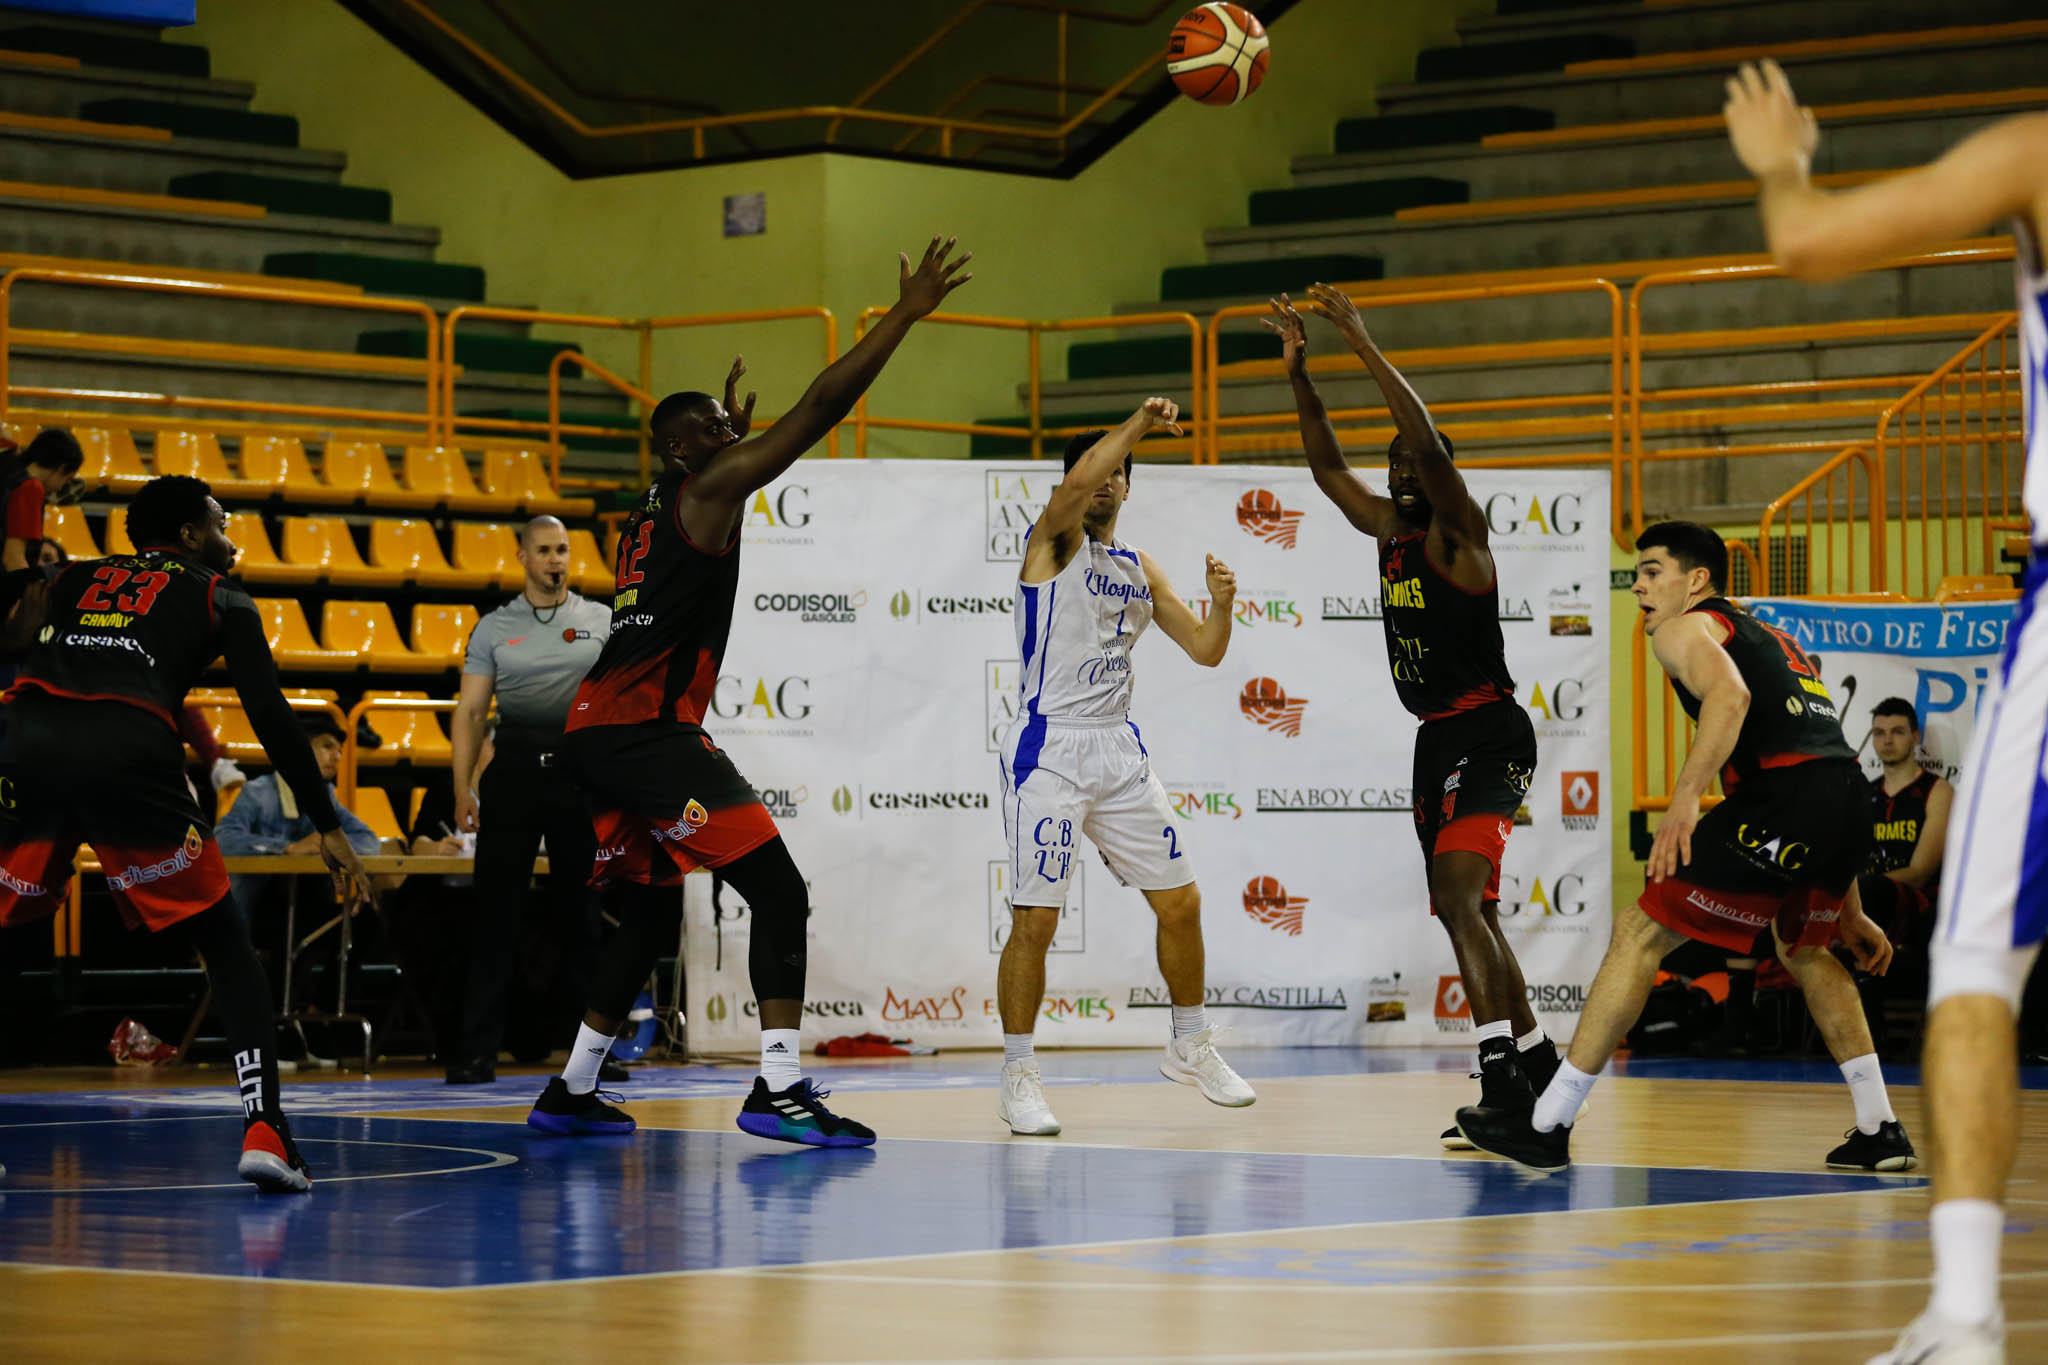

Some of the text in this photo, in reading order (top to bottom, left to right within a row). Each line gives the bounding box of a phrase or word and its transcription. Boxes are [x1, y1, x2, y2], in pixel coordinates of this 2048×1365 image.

[745, 484, 813, 529] AG
[1485, 492, 1586, 536] GAG
[76, 566, 170, 616] 23
[754, 593, 857, 612] CODISOIL
[927, 596, 1014, 613] casase
[710, 674, 815, 721] GAG
[1528, 678, 1587, 721] AG
[869, 791, 990, 809] casaseca
[1256, 787, 1354, 807] ENABOY
[1033, 817, 1075, 849] C.B.
[1163, 825, 1182, 860] 2
[1874, 819, 1917, 843] RMES
[1497, 872, 1586, 918] GAG
[1233, 986, 1347, 1005] CASTILLA
